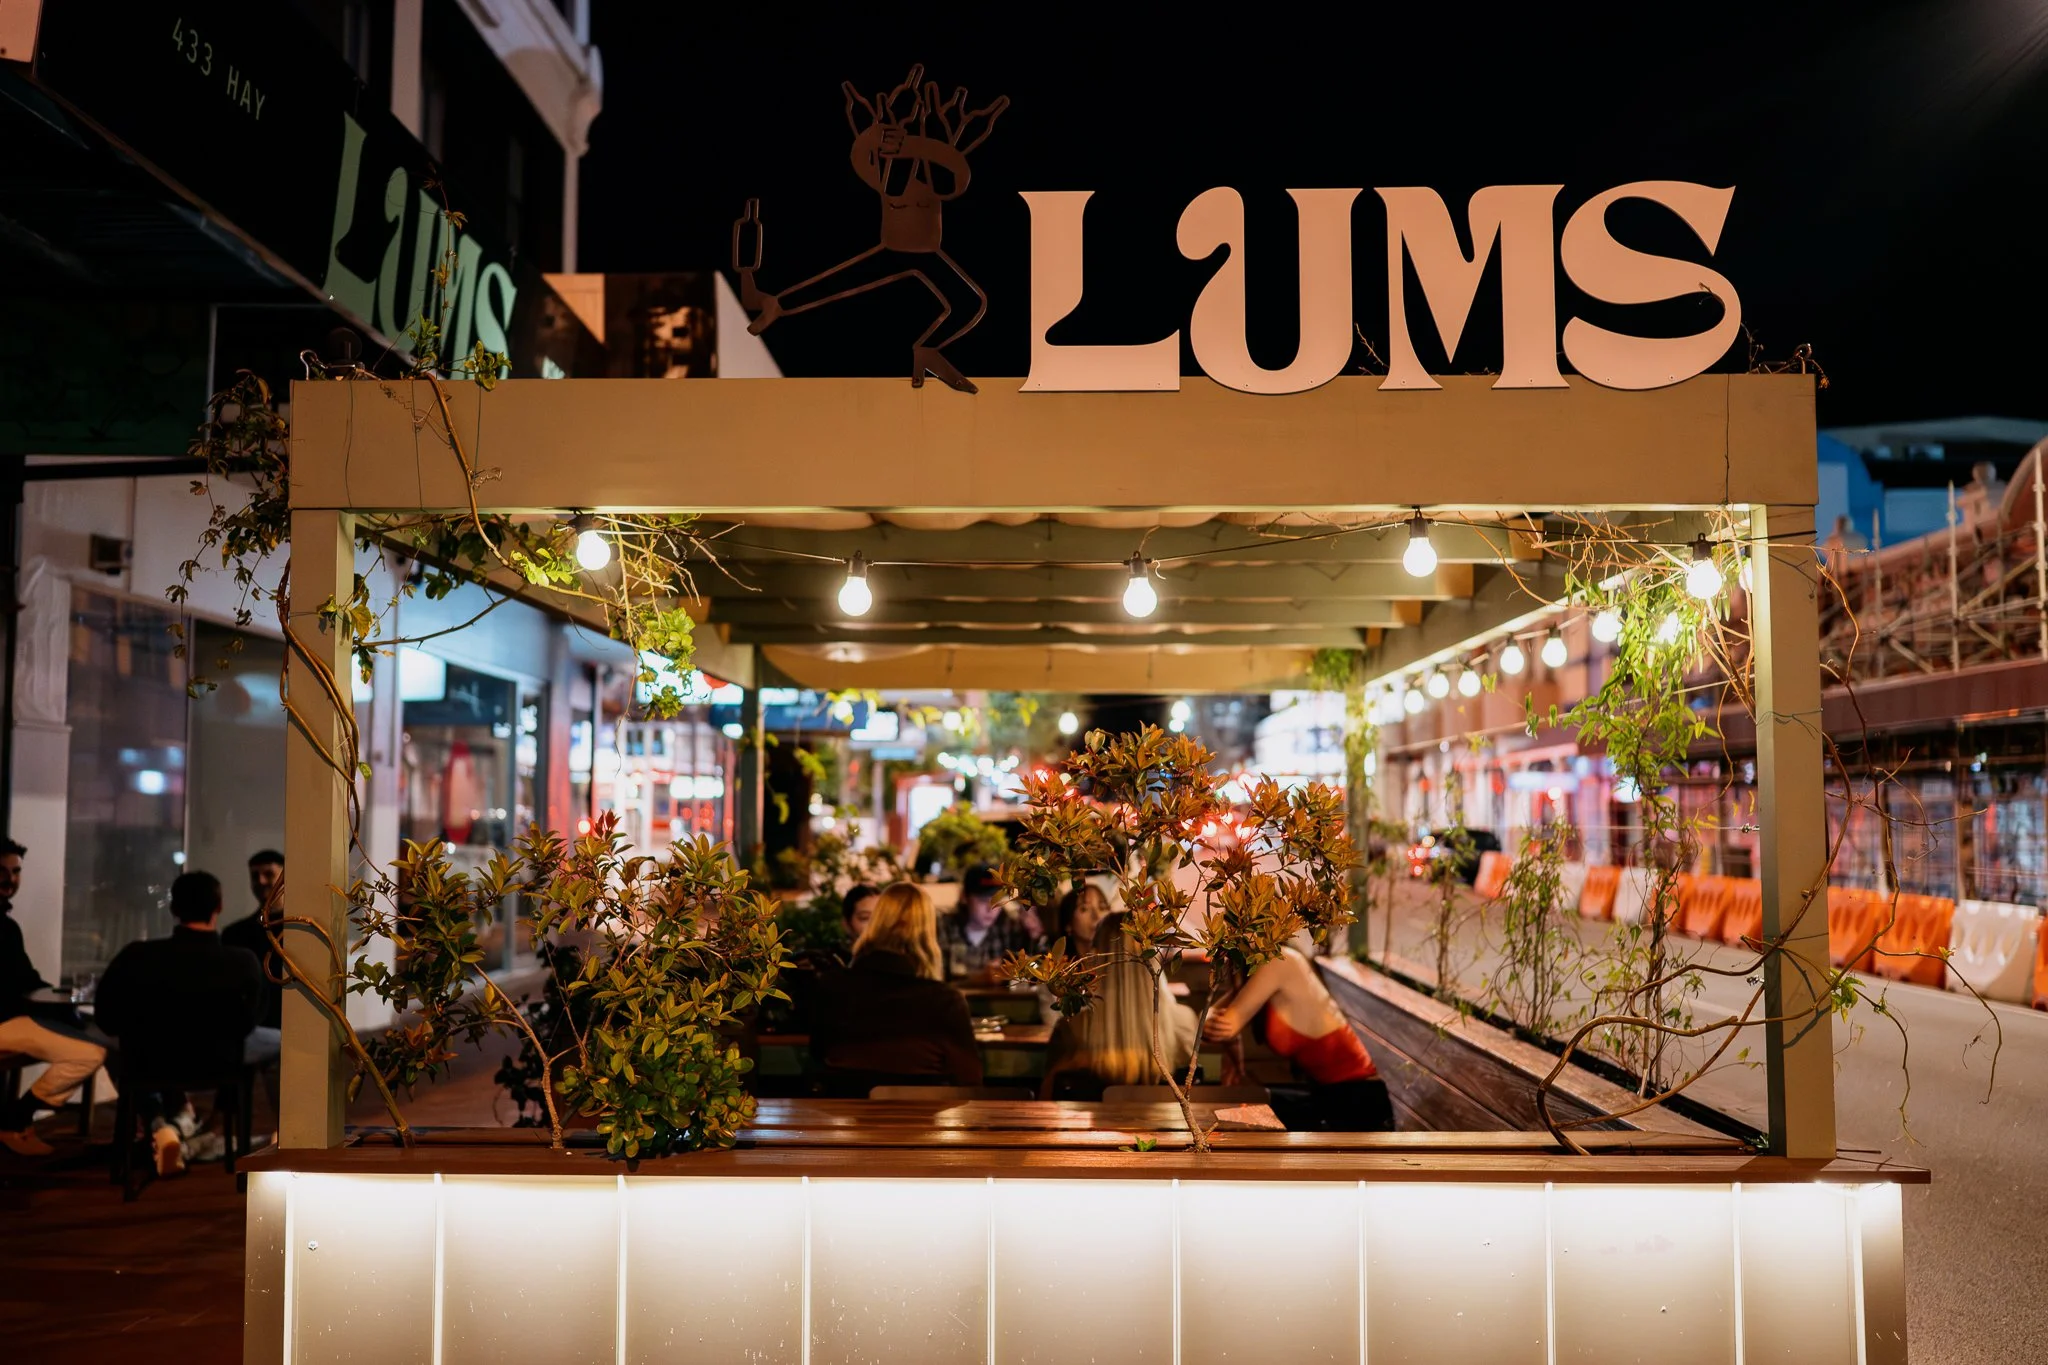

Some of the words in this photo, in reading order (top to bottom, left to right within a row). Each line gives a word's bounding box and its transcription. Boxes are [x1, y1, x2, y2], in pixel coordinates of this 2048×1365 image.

[172, 17, 213, 76] 433
[226, 65, 266, 121] HAY
[322, 110, 518, 380] LUMS
[1018, 180, 1742, 395] LUMS
